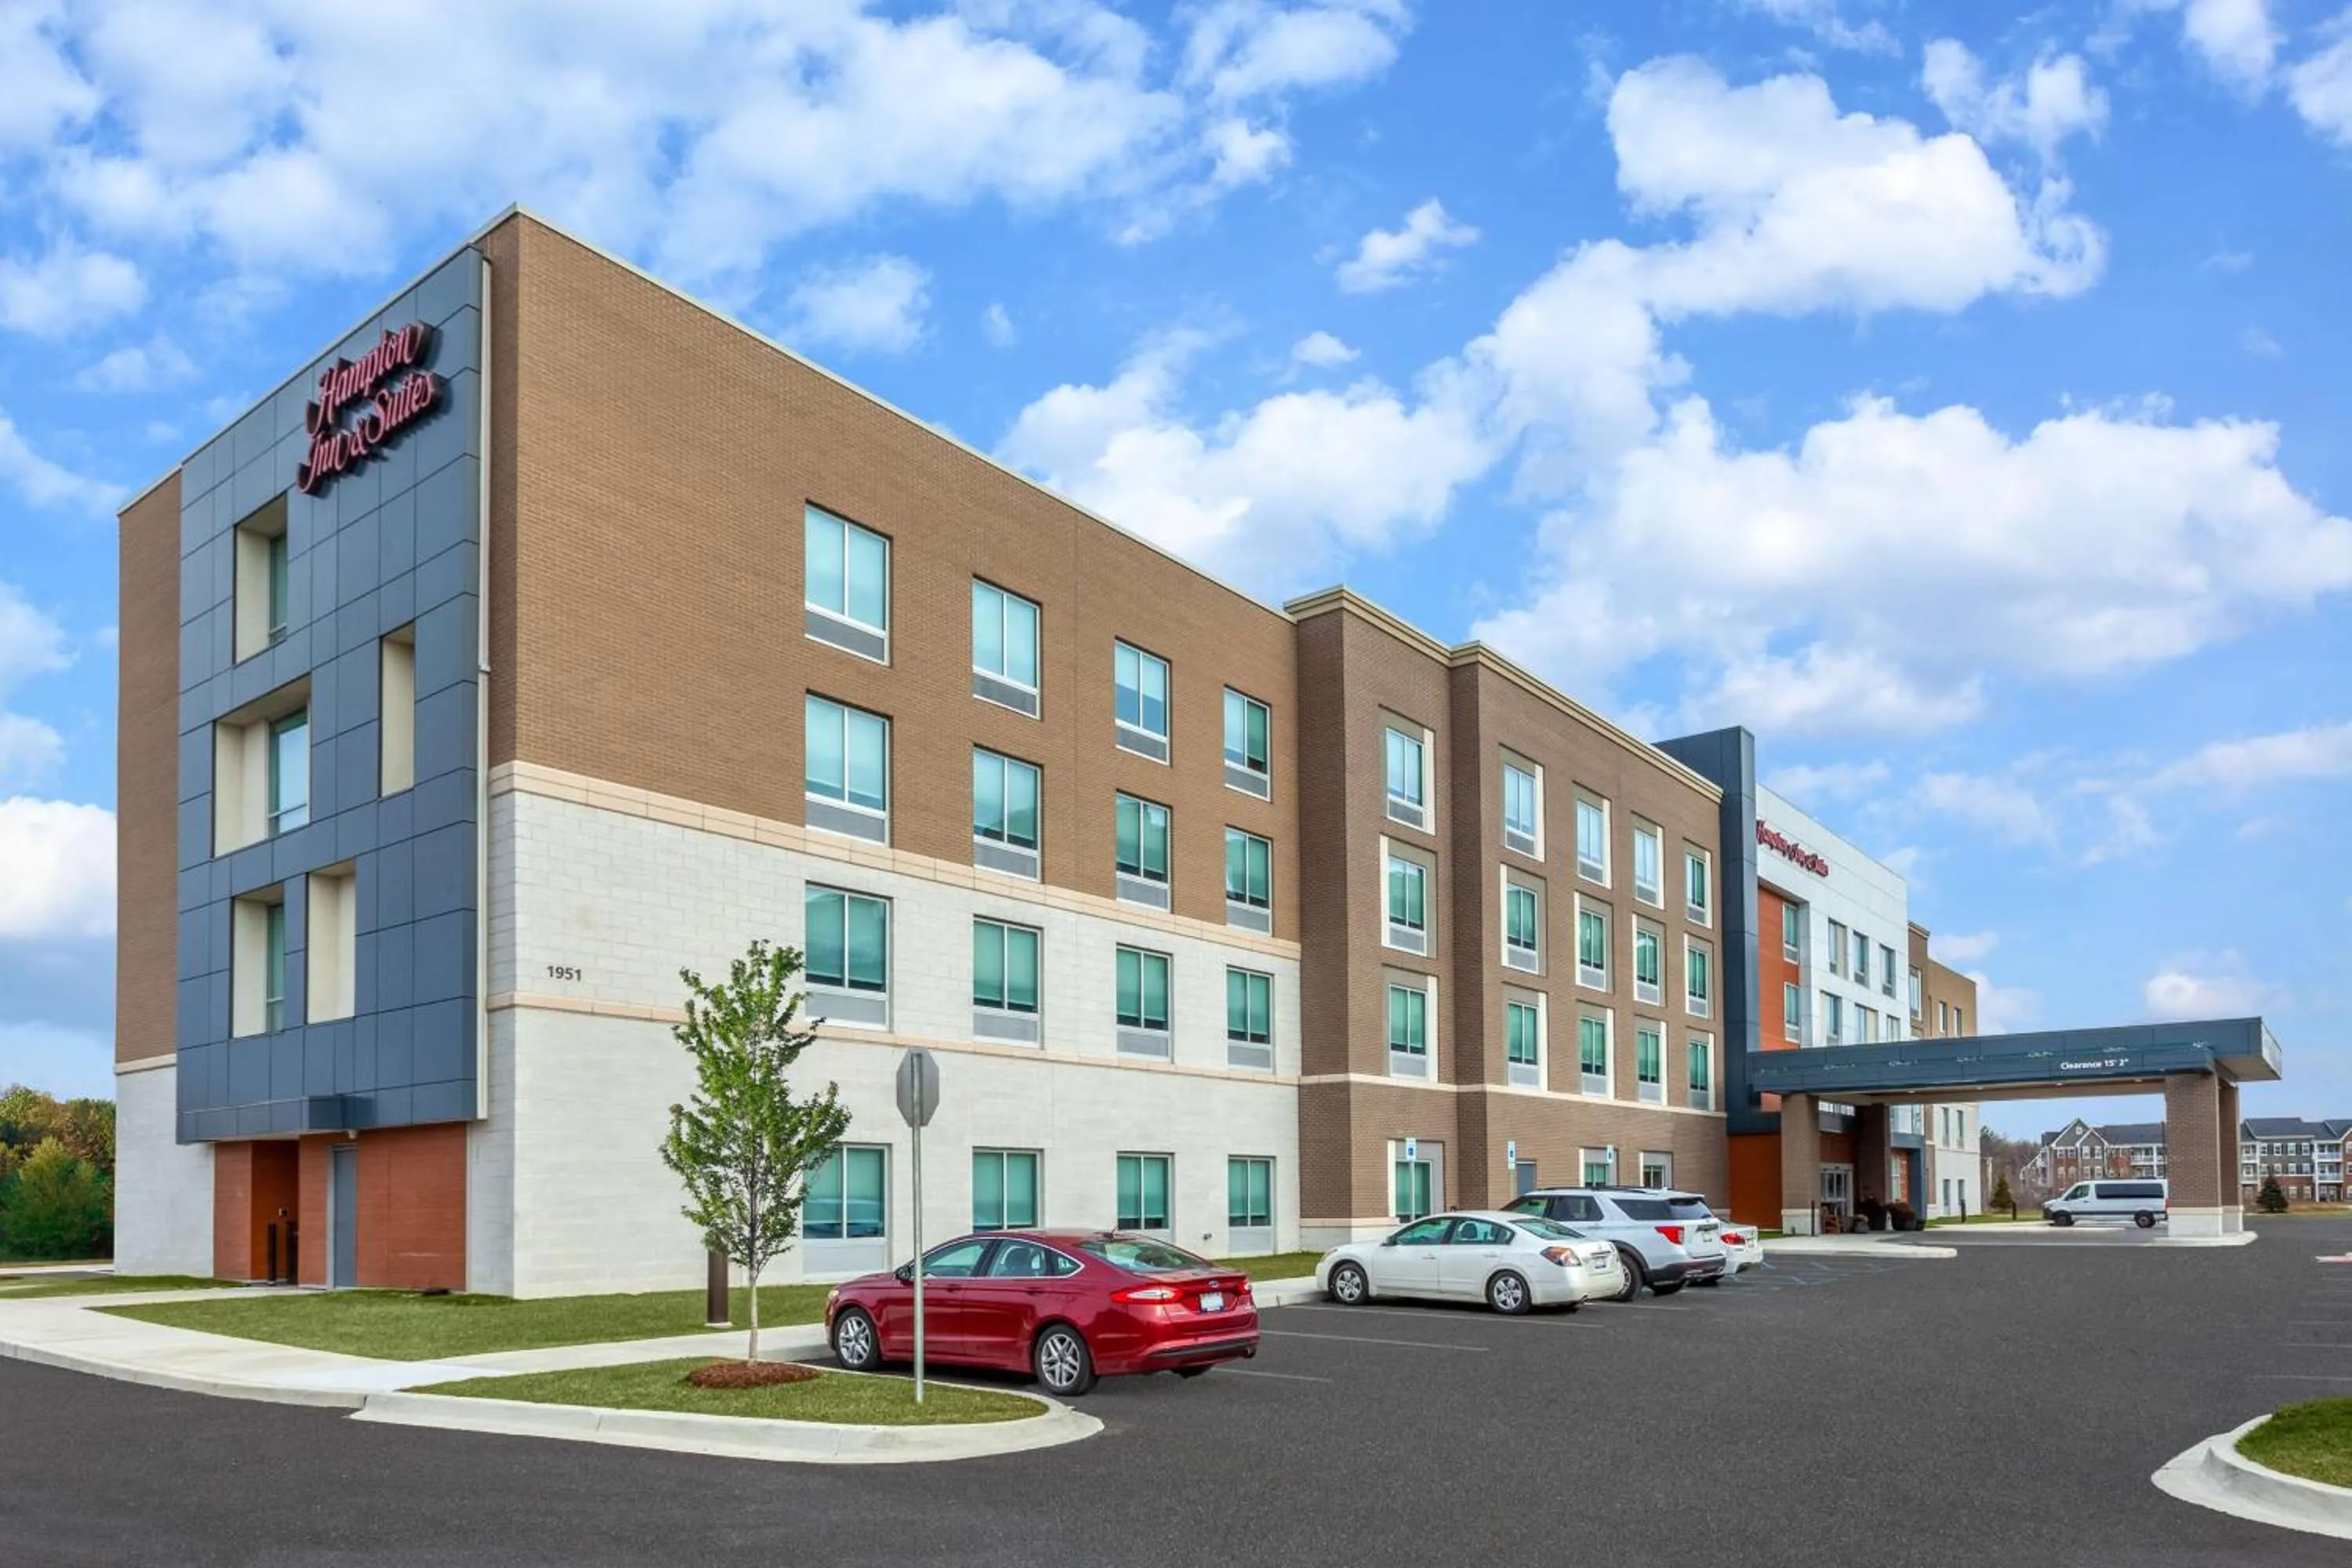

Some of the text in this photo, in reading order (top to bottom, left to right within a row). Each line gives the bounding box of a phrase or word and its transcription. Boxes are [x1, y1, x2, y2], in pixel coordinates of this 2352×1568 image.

[298, 430, 353, 494] Inn
[364, 370, 437, 444] Suites
[306, 321, 433, 436] Hampton
[546, 965, 582, 982] 1951
